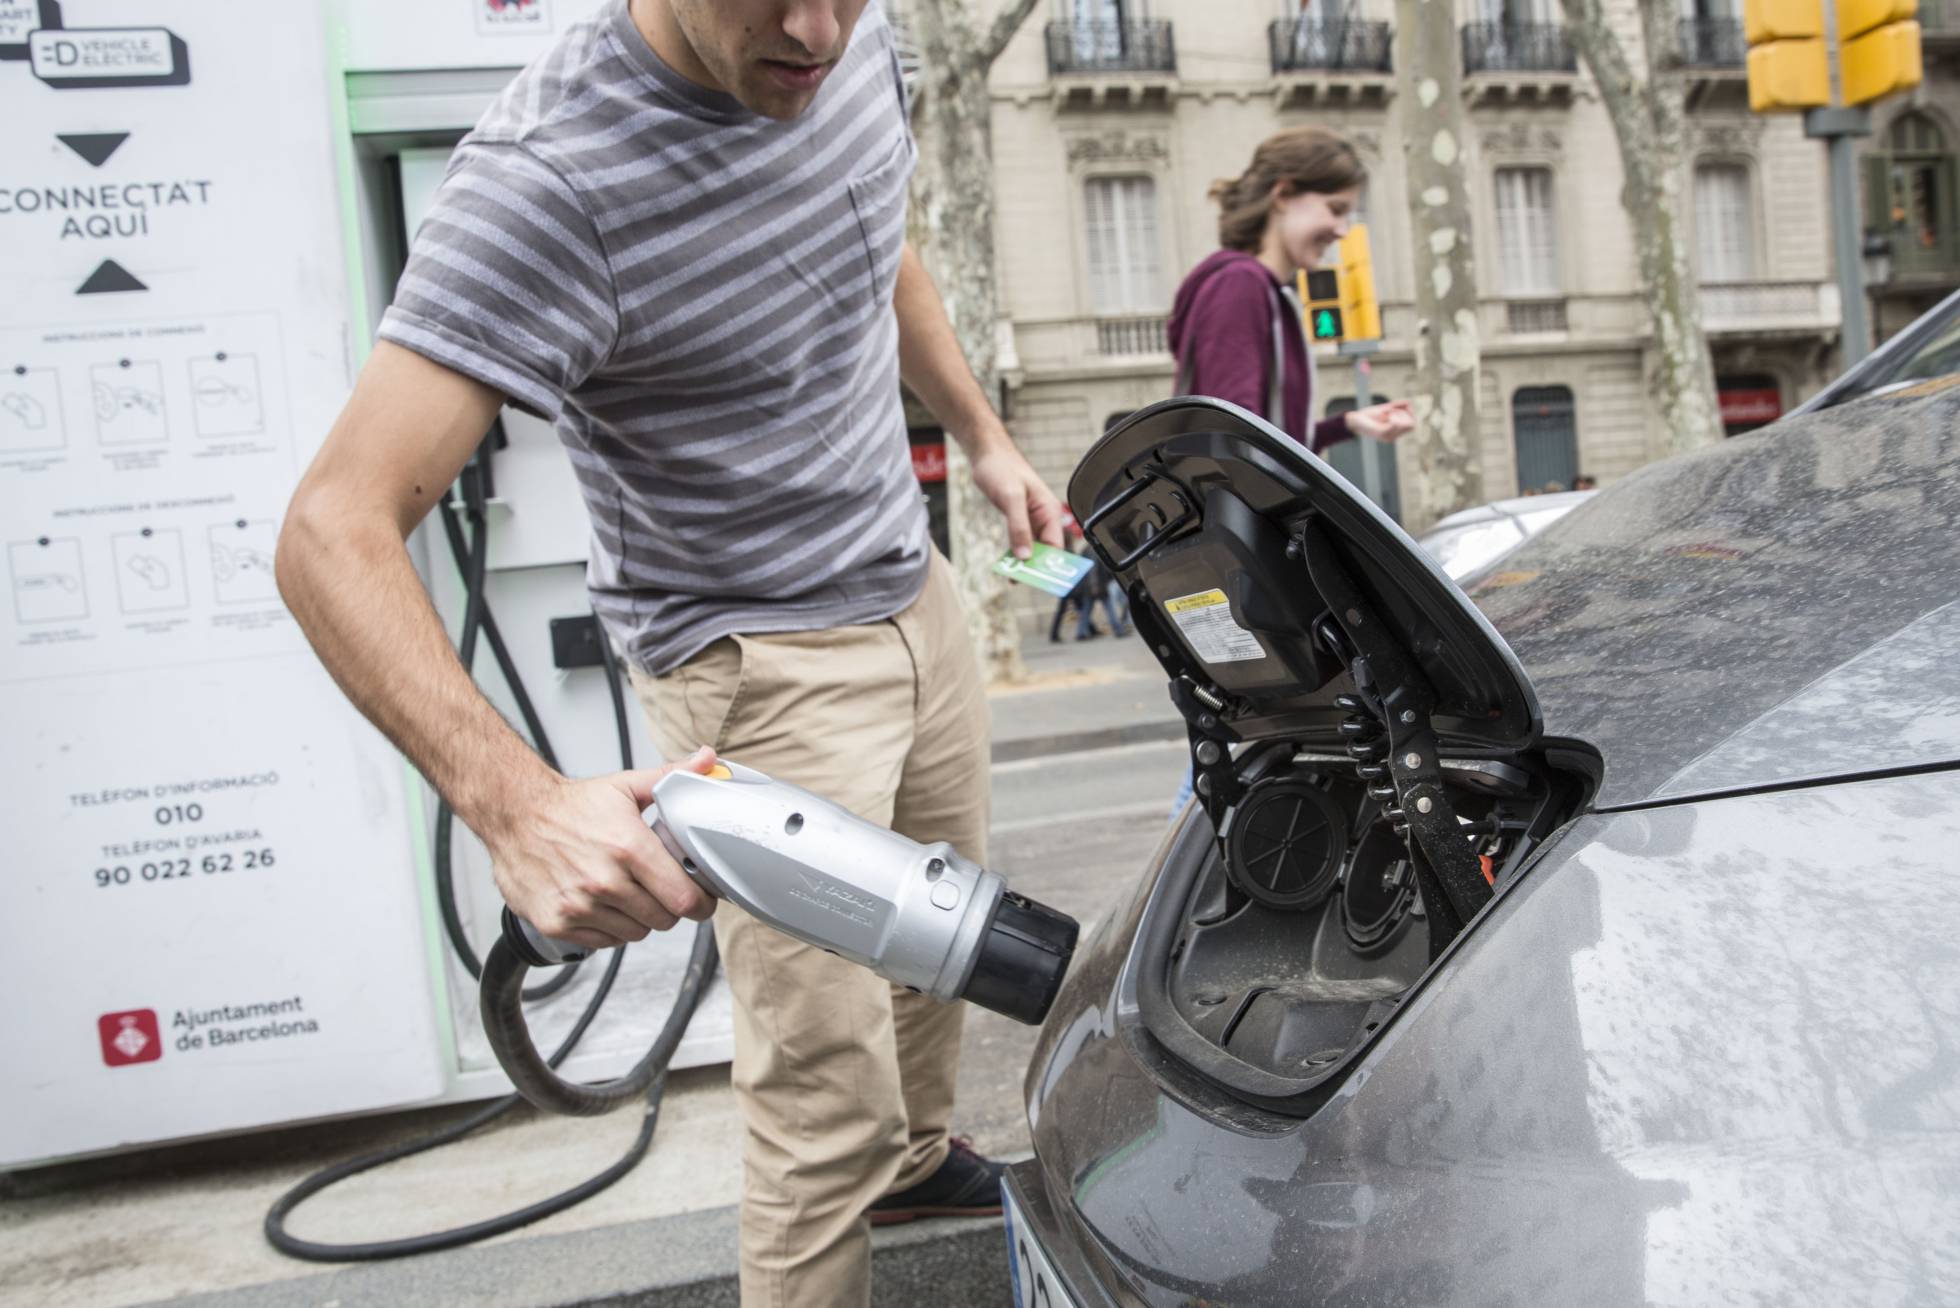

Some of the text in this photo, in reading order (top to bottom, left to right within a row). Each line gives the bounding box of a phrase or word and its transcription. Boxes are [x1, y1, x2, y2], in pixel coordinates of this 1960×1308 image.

[81, 39, 151, 52] VEHICLE
[155, 803, 203, 825] 010
[95, 848, 275, 887] 90 022 62 26
[172, 996, 303, 1030] Ajuntament
[175, 1018, 319, 1051] de Barcelona
